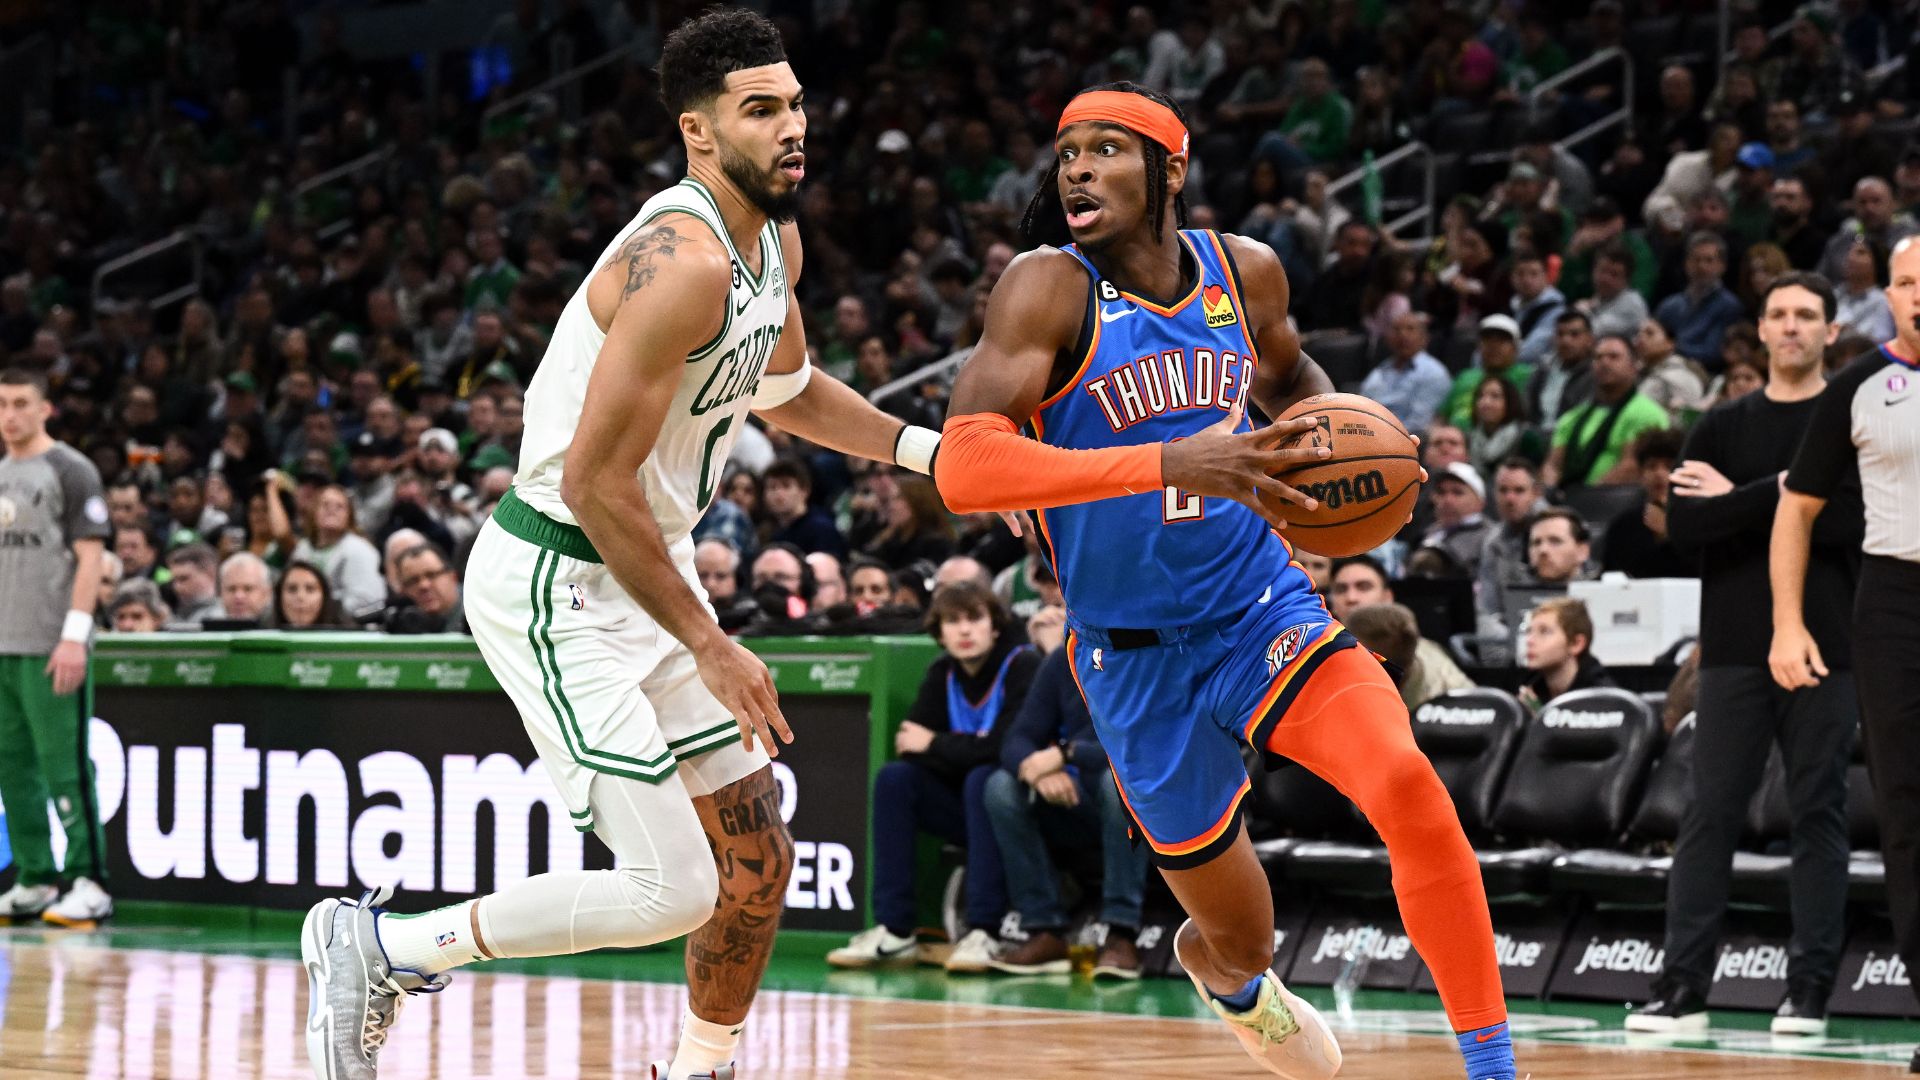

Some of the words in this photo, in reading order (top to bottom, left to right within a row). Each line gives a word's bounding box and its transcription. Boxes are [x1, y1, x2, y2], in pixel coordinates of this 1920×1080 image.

[1101, 280, 1119, 299] 6
[690, 324, 783, 416] CELTIC
[1084, 347, 1255, 433] THUNDER
[1280, 469, 1389, 510] Wilso
[1558, 708, 1624, 728] Putnam
[1312, 925, 1412, 964] jetBlue
[1574, 936, 1665, 975] jetBlu
